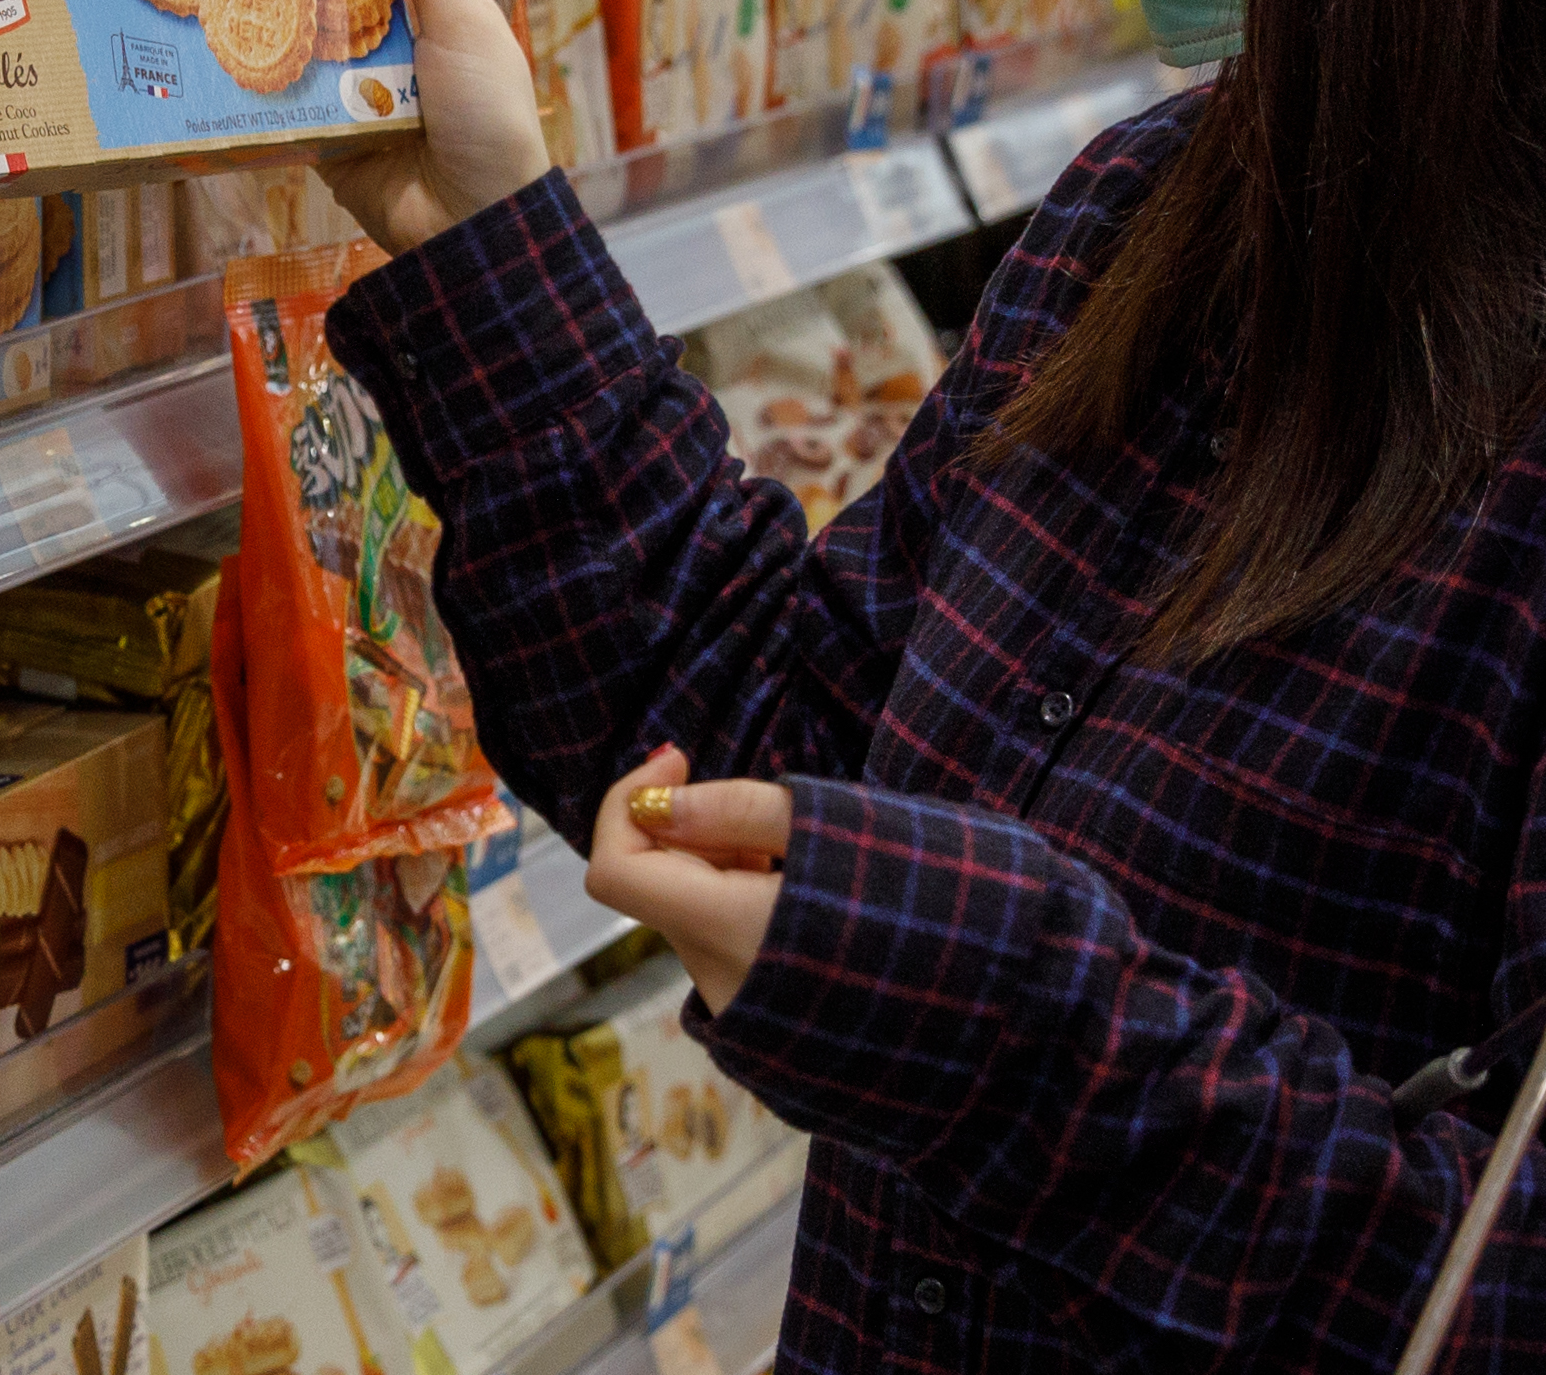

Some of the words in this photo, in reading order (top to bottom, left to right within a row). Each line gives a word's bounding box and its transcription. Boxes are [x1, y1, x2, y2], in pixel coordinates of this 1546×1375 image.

[134, 67, 178, 86] FRANCE
[5, 103, 37, 120] Coco
[21, 121, 70, 140] Cookies
